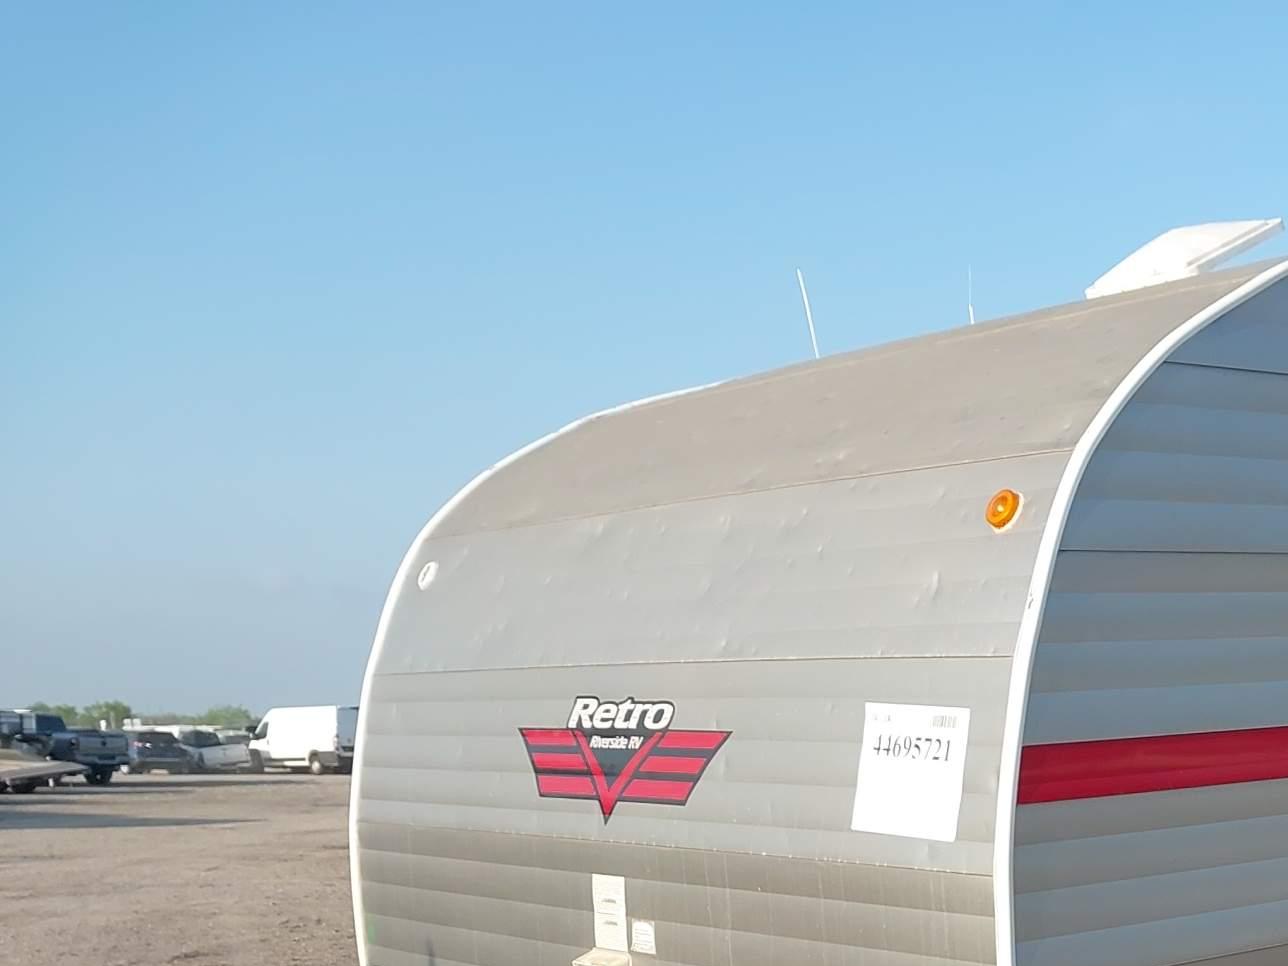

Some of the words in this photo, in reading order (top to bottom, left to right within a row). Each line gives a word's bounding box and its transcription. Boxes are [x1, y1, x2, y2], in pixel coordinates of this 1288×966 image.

[567, 697, 674, 730] Retro
[590, 736, 628, 749] Riverside
[628, 736, 644, 749] RV
[873, 734, 950, 761] 44695721
